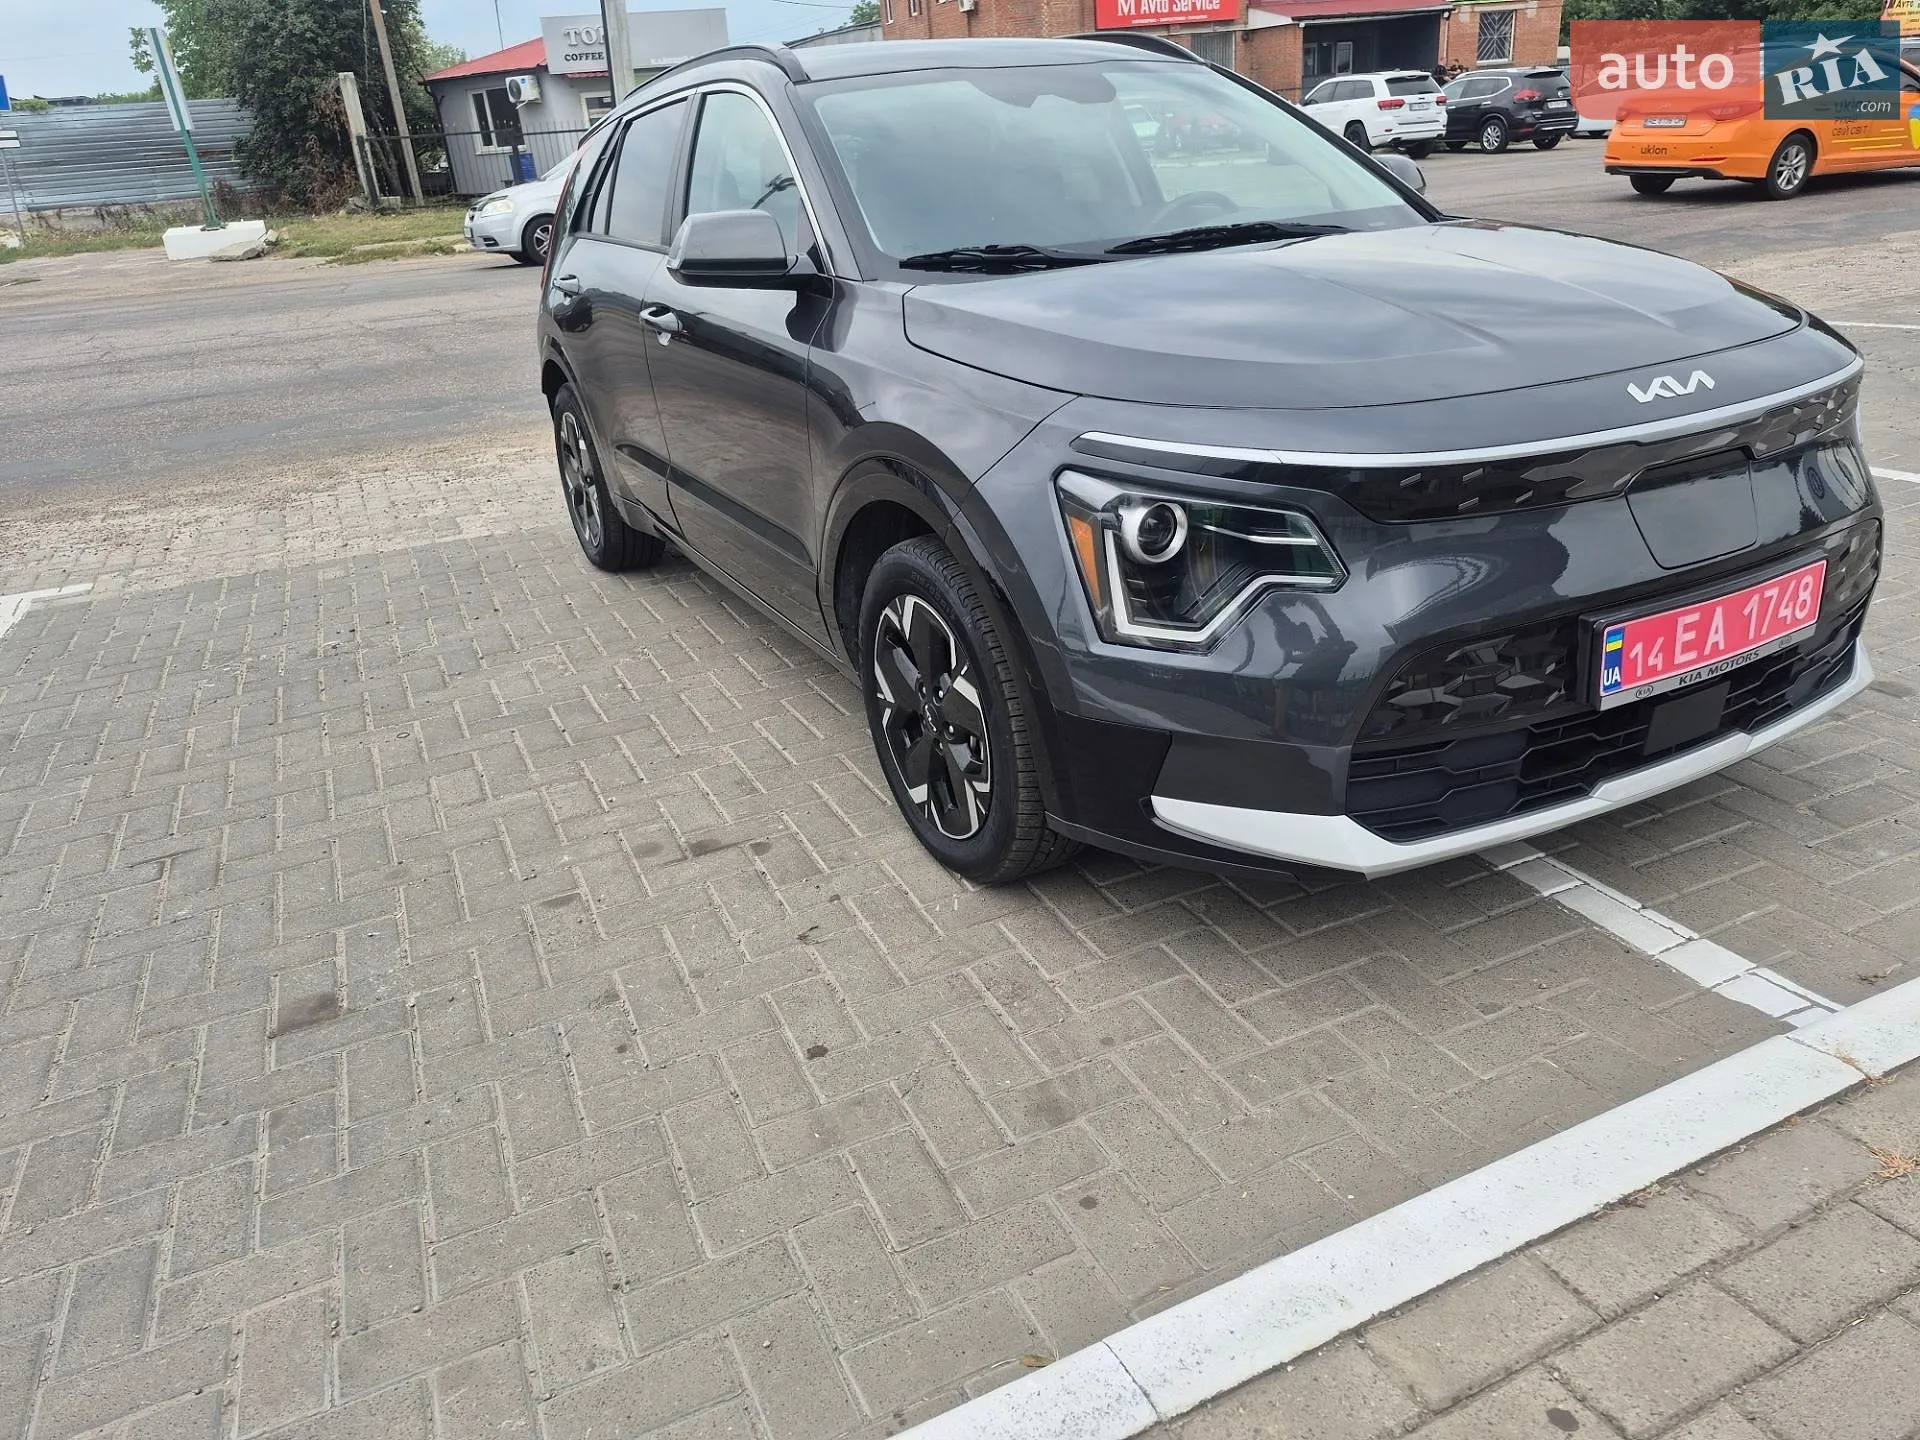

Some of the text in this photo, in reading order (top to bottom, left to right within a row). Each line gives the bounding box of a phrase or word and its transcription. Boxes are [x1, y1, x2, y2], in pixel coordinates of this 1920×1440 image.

[564, 52, 605, 62] COFFEE
[1640, 144, 1668, 155] uklon
[1629, 636, 1665, 677] 14
[1743, 575, 1814, 640] 1748
[1678, 650, 1760, 686] KIA MOTORS
[1603, 669, 1621, 686] UA
